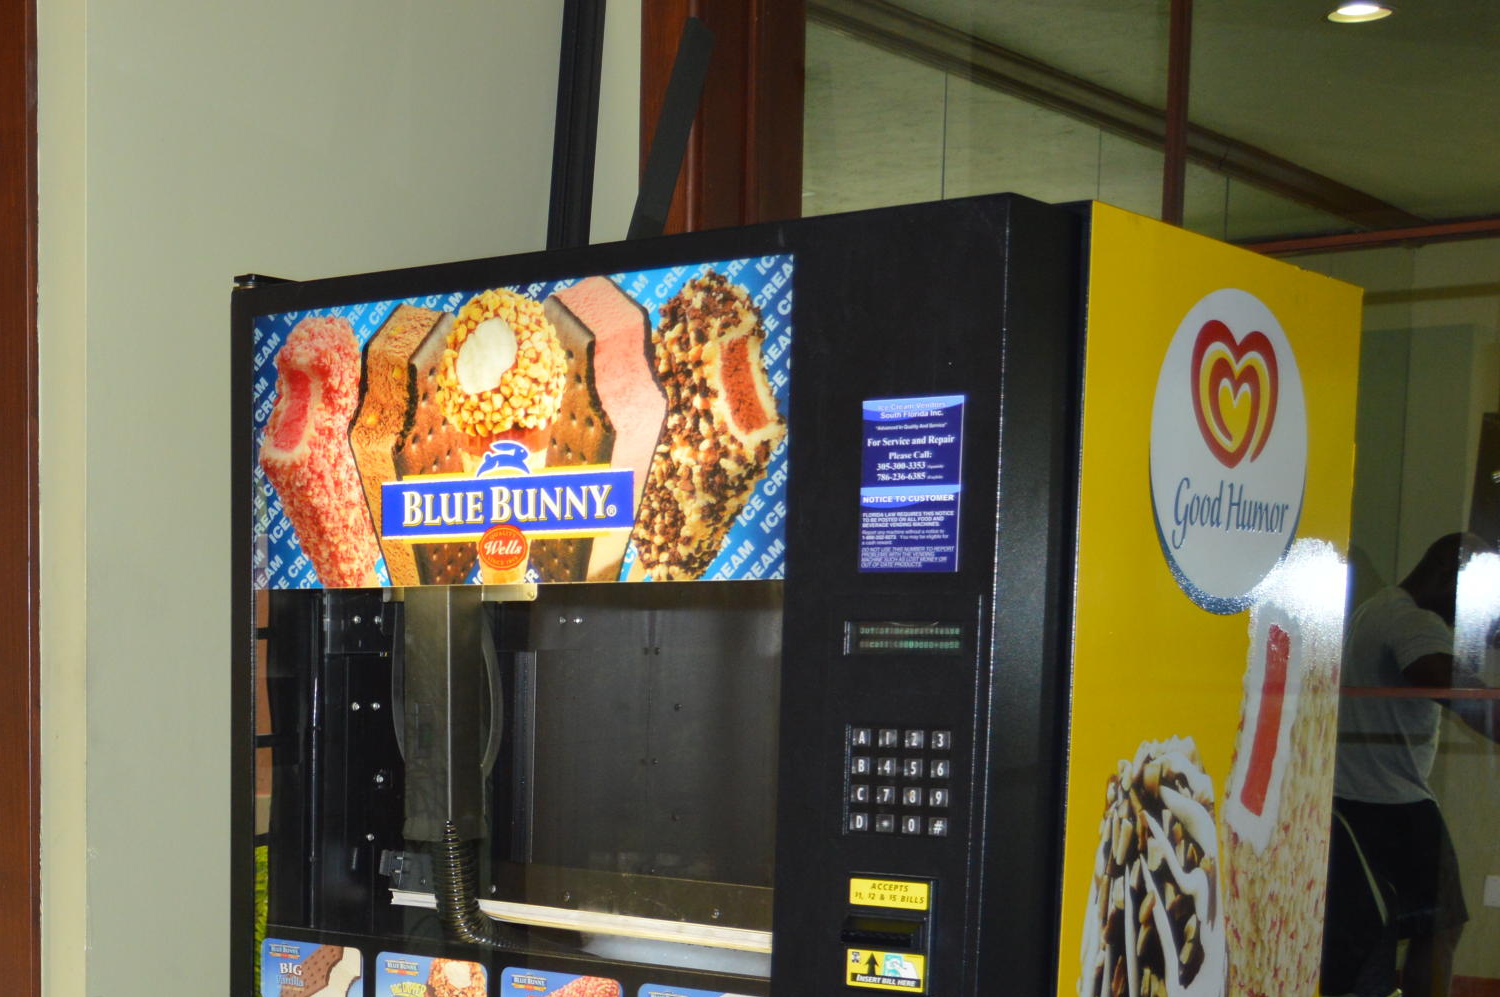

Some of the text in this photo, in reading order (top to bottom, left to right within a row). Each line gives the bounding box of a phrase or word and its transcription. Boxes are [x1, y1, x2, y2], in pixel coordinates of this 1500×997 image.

[880, 411, 902, 420] South
[903, 410, 928, 419] Florida
[867, 434, 956, 447] For Service and Repair
[889, 450, 933, 460] Please Call:
[862, 494, 955, 504] NOTICE TO CUSTOMER
[402, 490, 485, 527] BLUE
[736, 494, 765, 527] ICE
[1172, 476, 1289, 550] Good Humor
[760, 501, 787, 534] ICE
[269, 516, 291, 545] ICE
[484, 539, 523, 555] Wells
[858, 731, 944, 747] A 1 2 3
[858, 759, 944, 776] B 4 5 6
[857, 787, 942, 805] C 7 8 9
[856, 815, 943, 835] D 0 #
[870, 882, 909, 893] ACCEPTS
[900, 895, 925, 904] BILLS
[280, 962, 303, 976] BIG
[856, 973, 917, 988] INSERT BILL HERE
